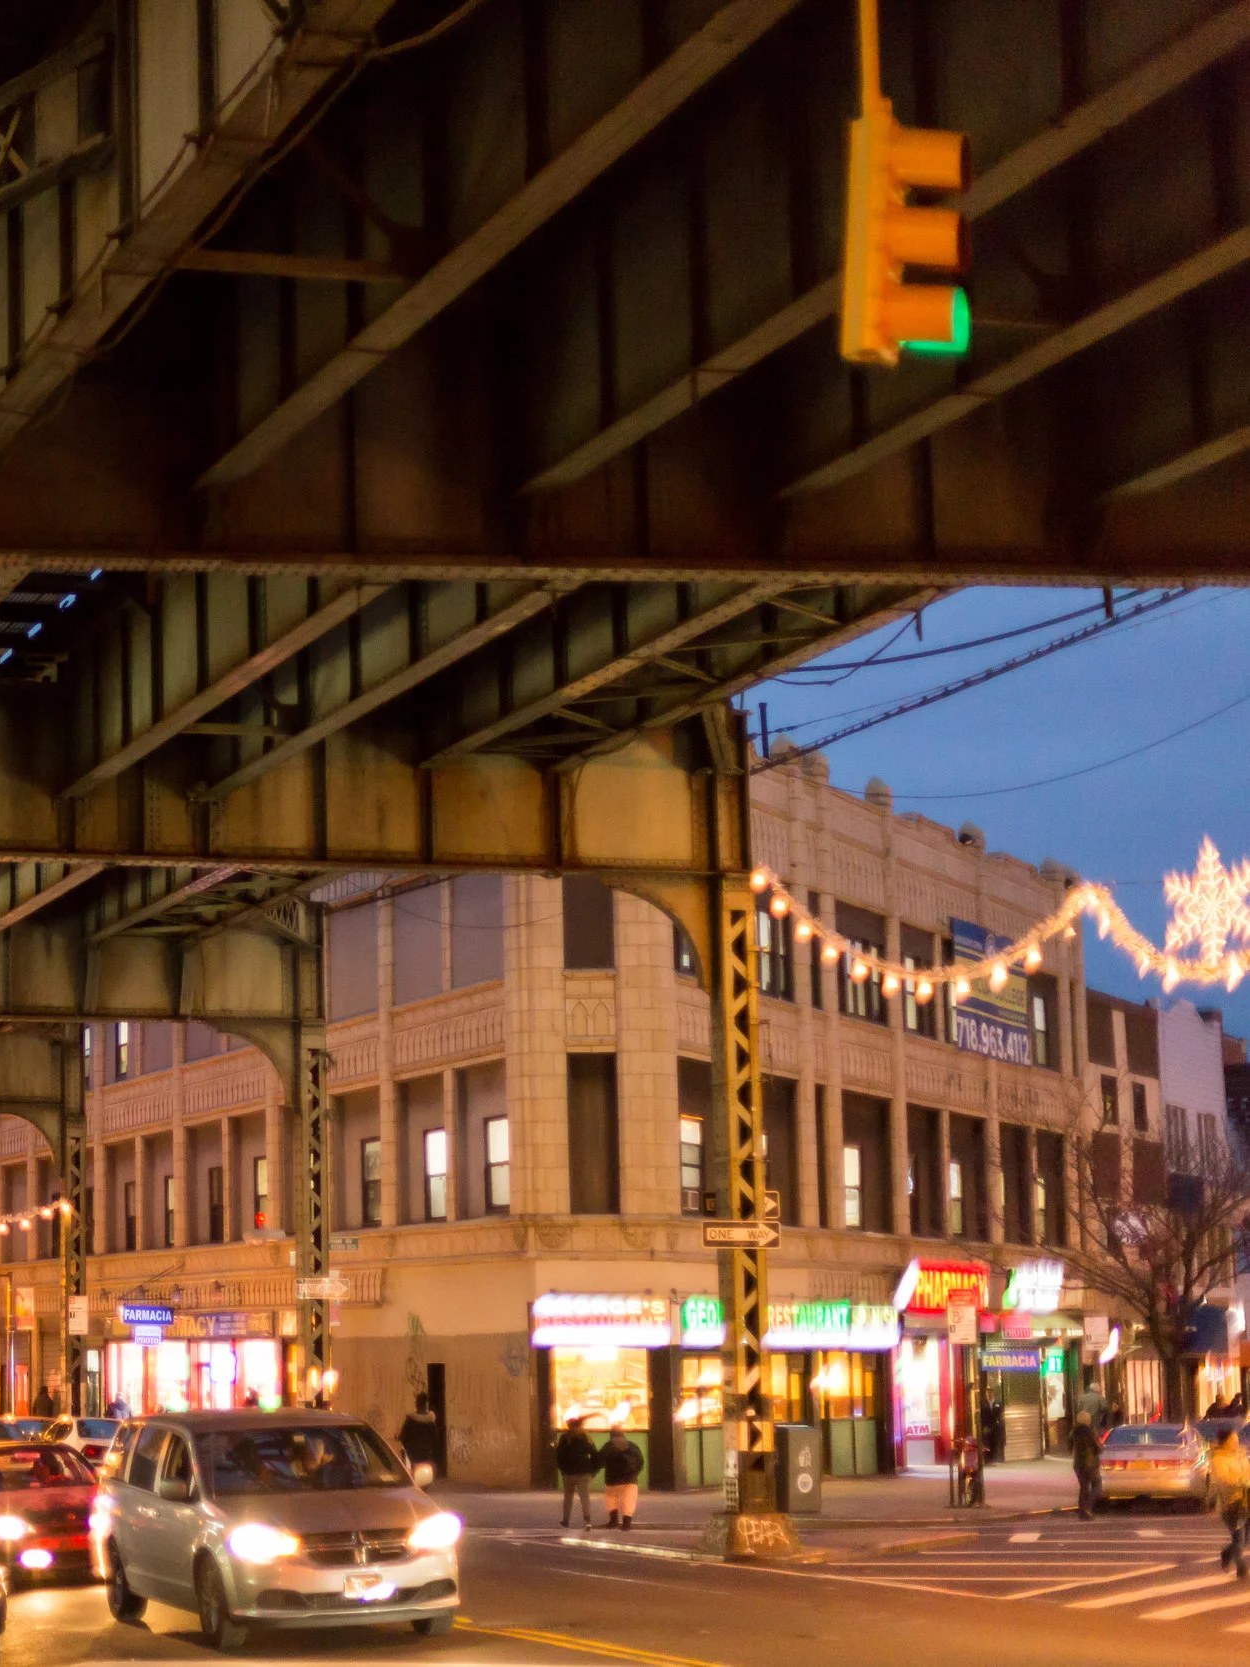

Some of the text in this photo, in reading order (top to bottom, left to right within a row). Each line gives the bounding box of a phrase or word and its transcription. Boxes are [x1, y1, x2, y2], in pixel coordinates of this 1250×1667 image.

[956, 1015, 1033, 1066] 718.963.4112
[710, 1229, 771, 1240] ONE WAY
[124, 1309, 172, 1322] FARMACIA
[686, 1301, 722, 1331] GEO
[767, 1304, 849, 1333] RESTAURANT
[136, 1336, 159, 1345] PHOTO
[983, 1355, 1037, 1368] FARMACIA
[907, 1424, 929, 1434] ATM
